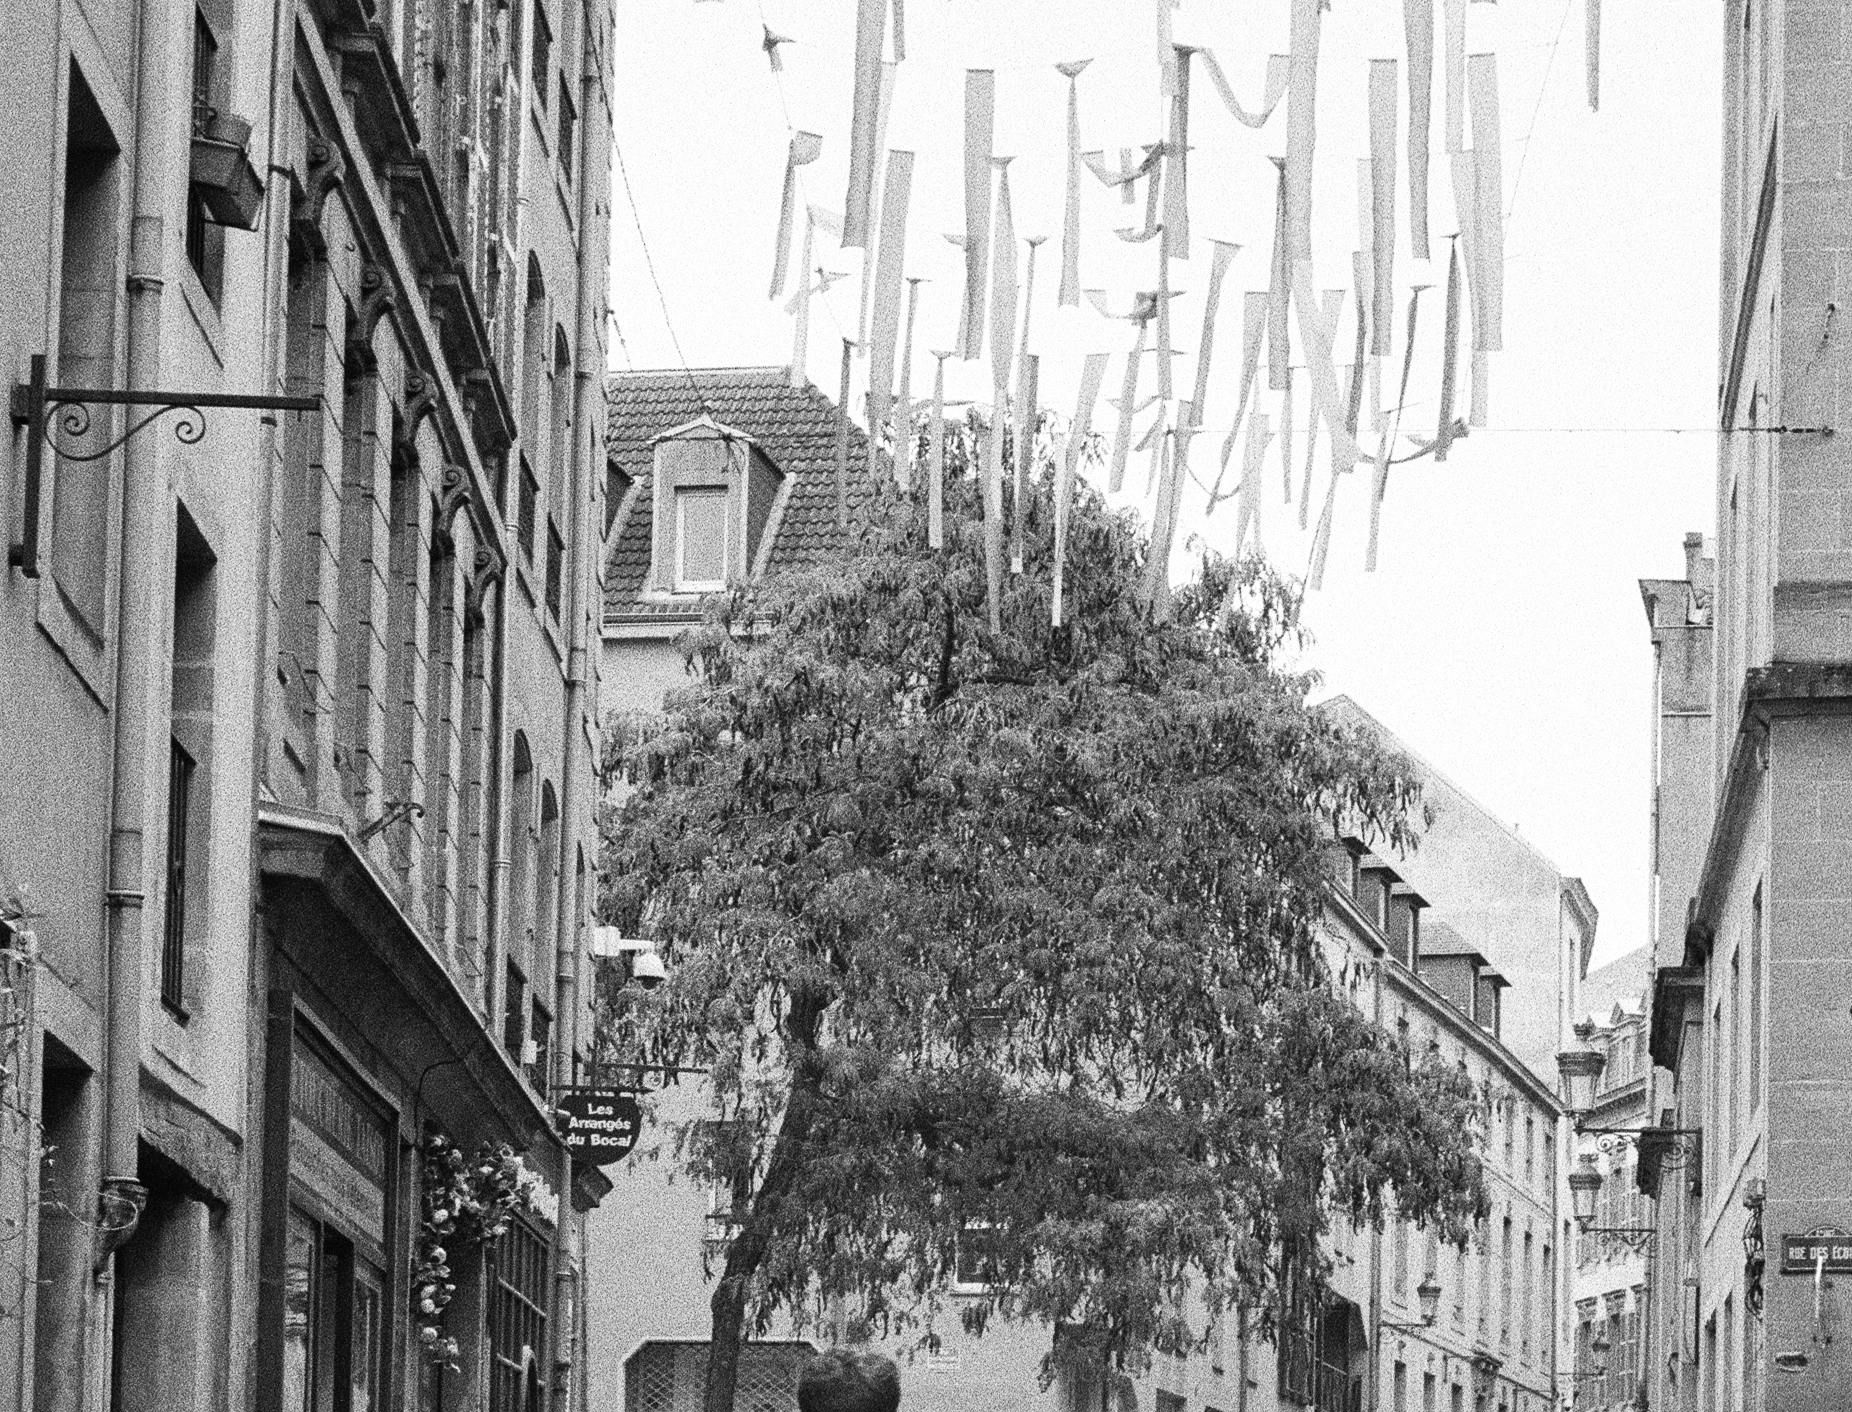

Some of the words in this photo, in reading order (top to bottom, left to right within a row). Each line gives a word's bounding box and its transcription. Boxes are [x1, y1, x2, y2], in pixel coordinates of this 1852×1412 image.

[587, 1103, 614, 1115] Les
[568, 1116, 632, 1132] Arrangés
[566, 1133, 586, 1145] du
[590, 1134, 632, 1147] Bocal
